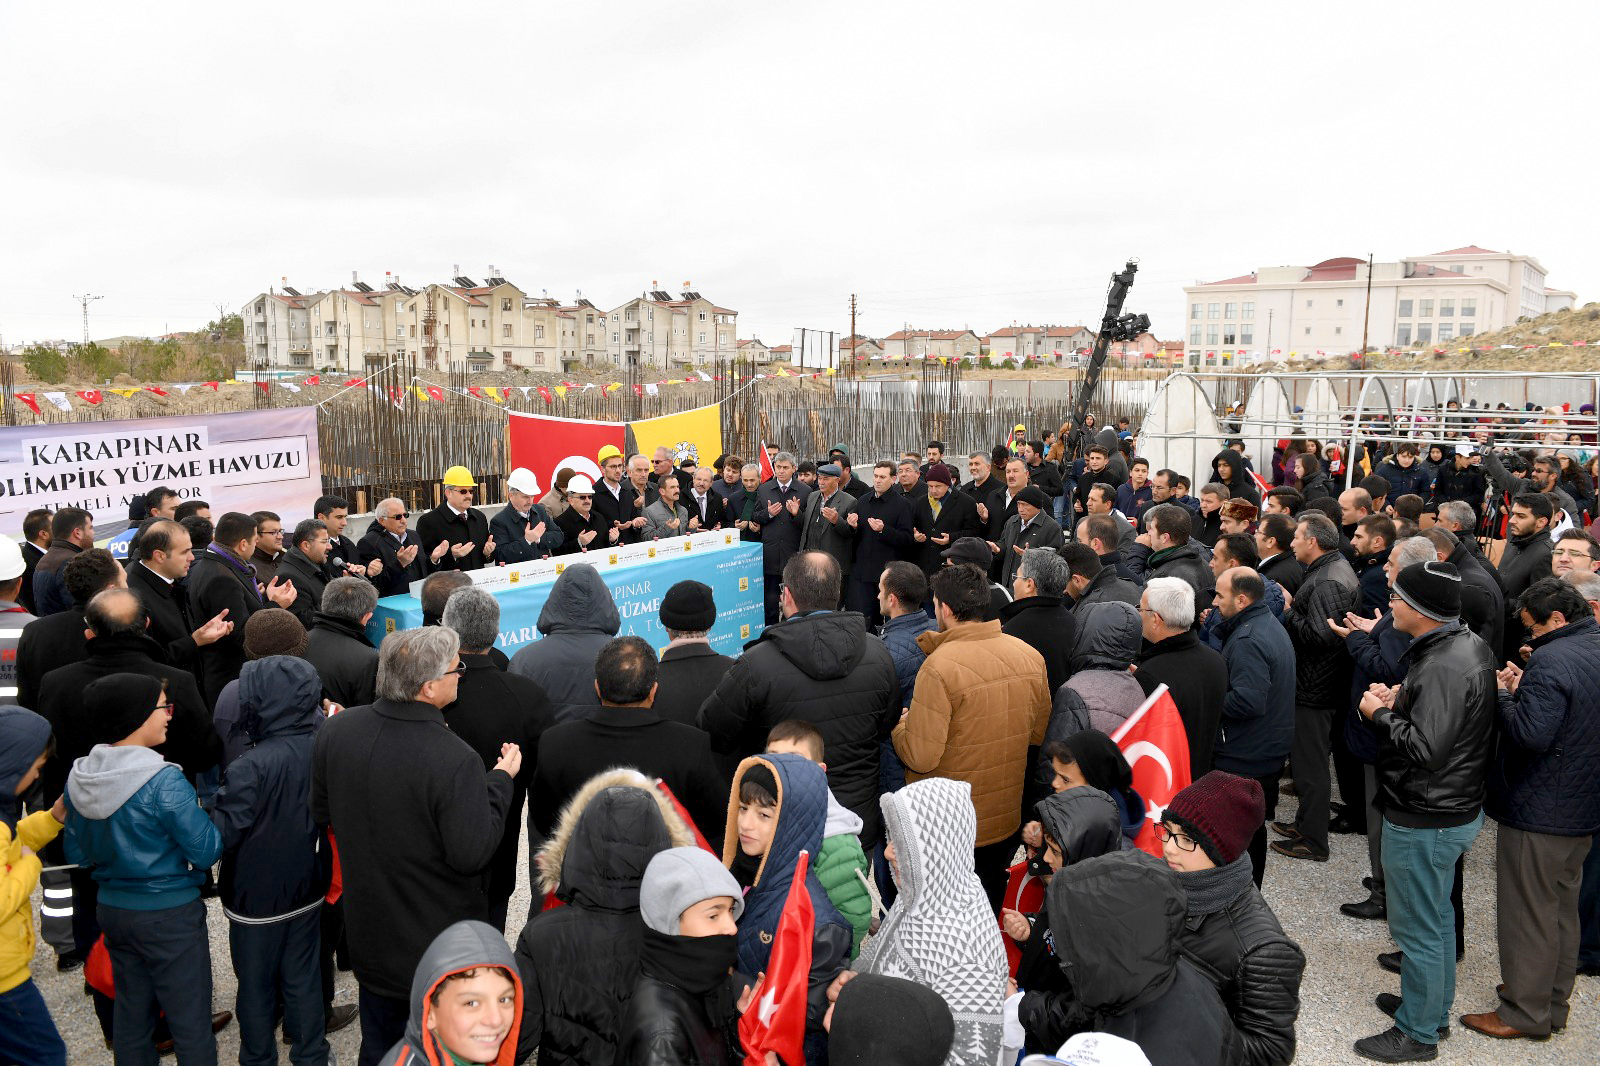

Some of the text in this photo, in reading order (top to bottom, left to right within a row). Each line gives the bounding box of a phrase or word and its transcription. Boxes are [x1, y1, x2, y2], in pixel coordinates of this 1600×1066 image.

[29, 432, 203, 467] KARAPINAR
[111, 460, 203, 485] YÜZME
[208, 450, 301, 475] HAVUZU
[110, 541, 131, 554] PO
[497, 625, 537, 647] YARI
